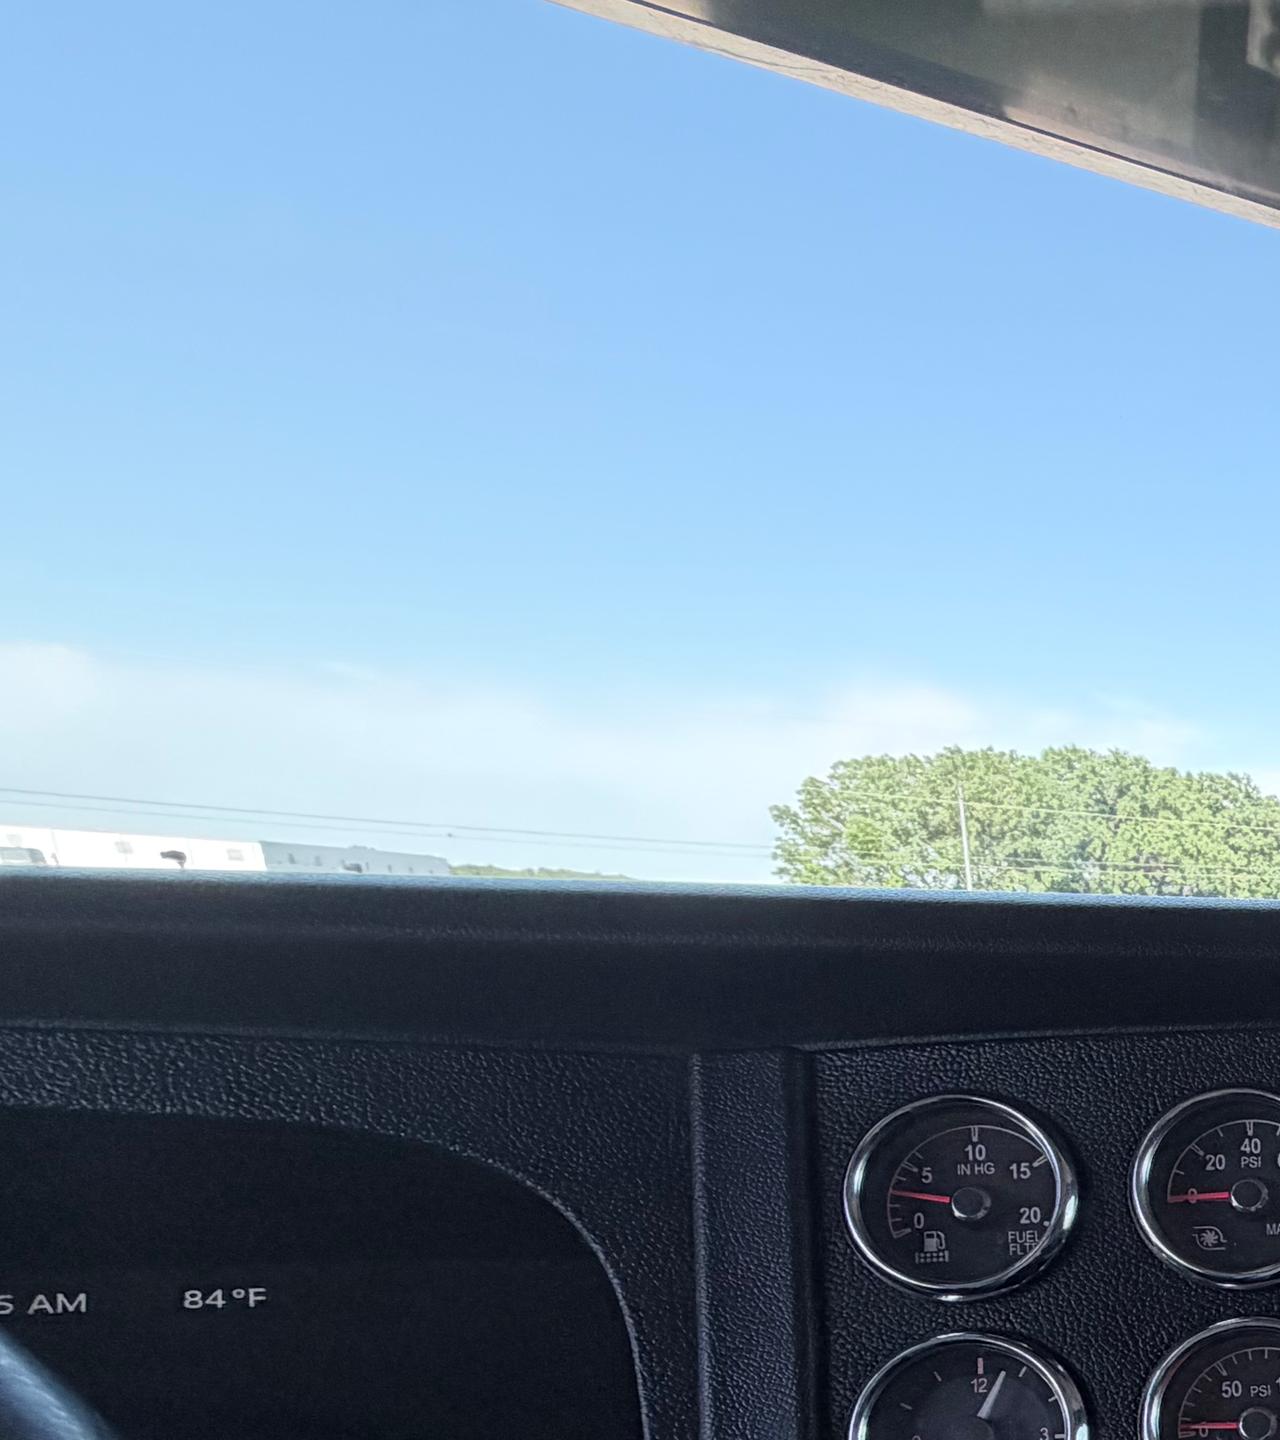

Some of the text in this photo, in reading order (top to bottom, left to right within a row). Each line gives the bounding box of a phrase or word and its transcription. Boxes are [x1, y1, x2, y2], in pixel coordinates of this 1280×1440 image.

[964, 1144, 987, 1161] 10
[1240, 1138, 1261, 1154] 40
[957, 1162, 995, 1176] IN HG
[1205, 1154, 1226, 1170] 20
[1240, 1156, 1261, 1169] PSI
[921, 1168, 933, 1183] 5
[1009, 1163, 1031, 1179] 15
[914, 1213, 925, 1229] 0
[1019, 1207, 1041, 1225] 20
[27, 1292, 88, 1316] AM
[970, 1377, 988, 1393] 12
[1221, 1380, 1242, 1398] 50
[1250, 1384, 1271, 1397] PSI
